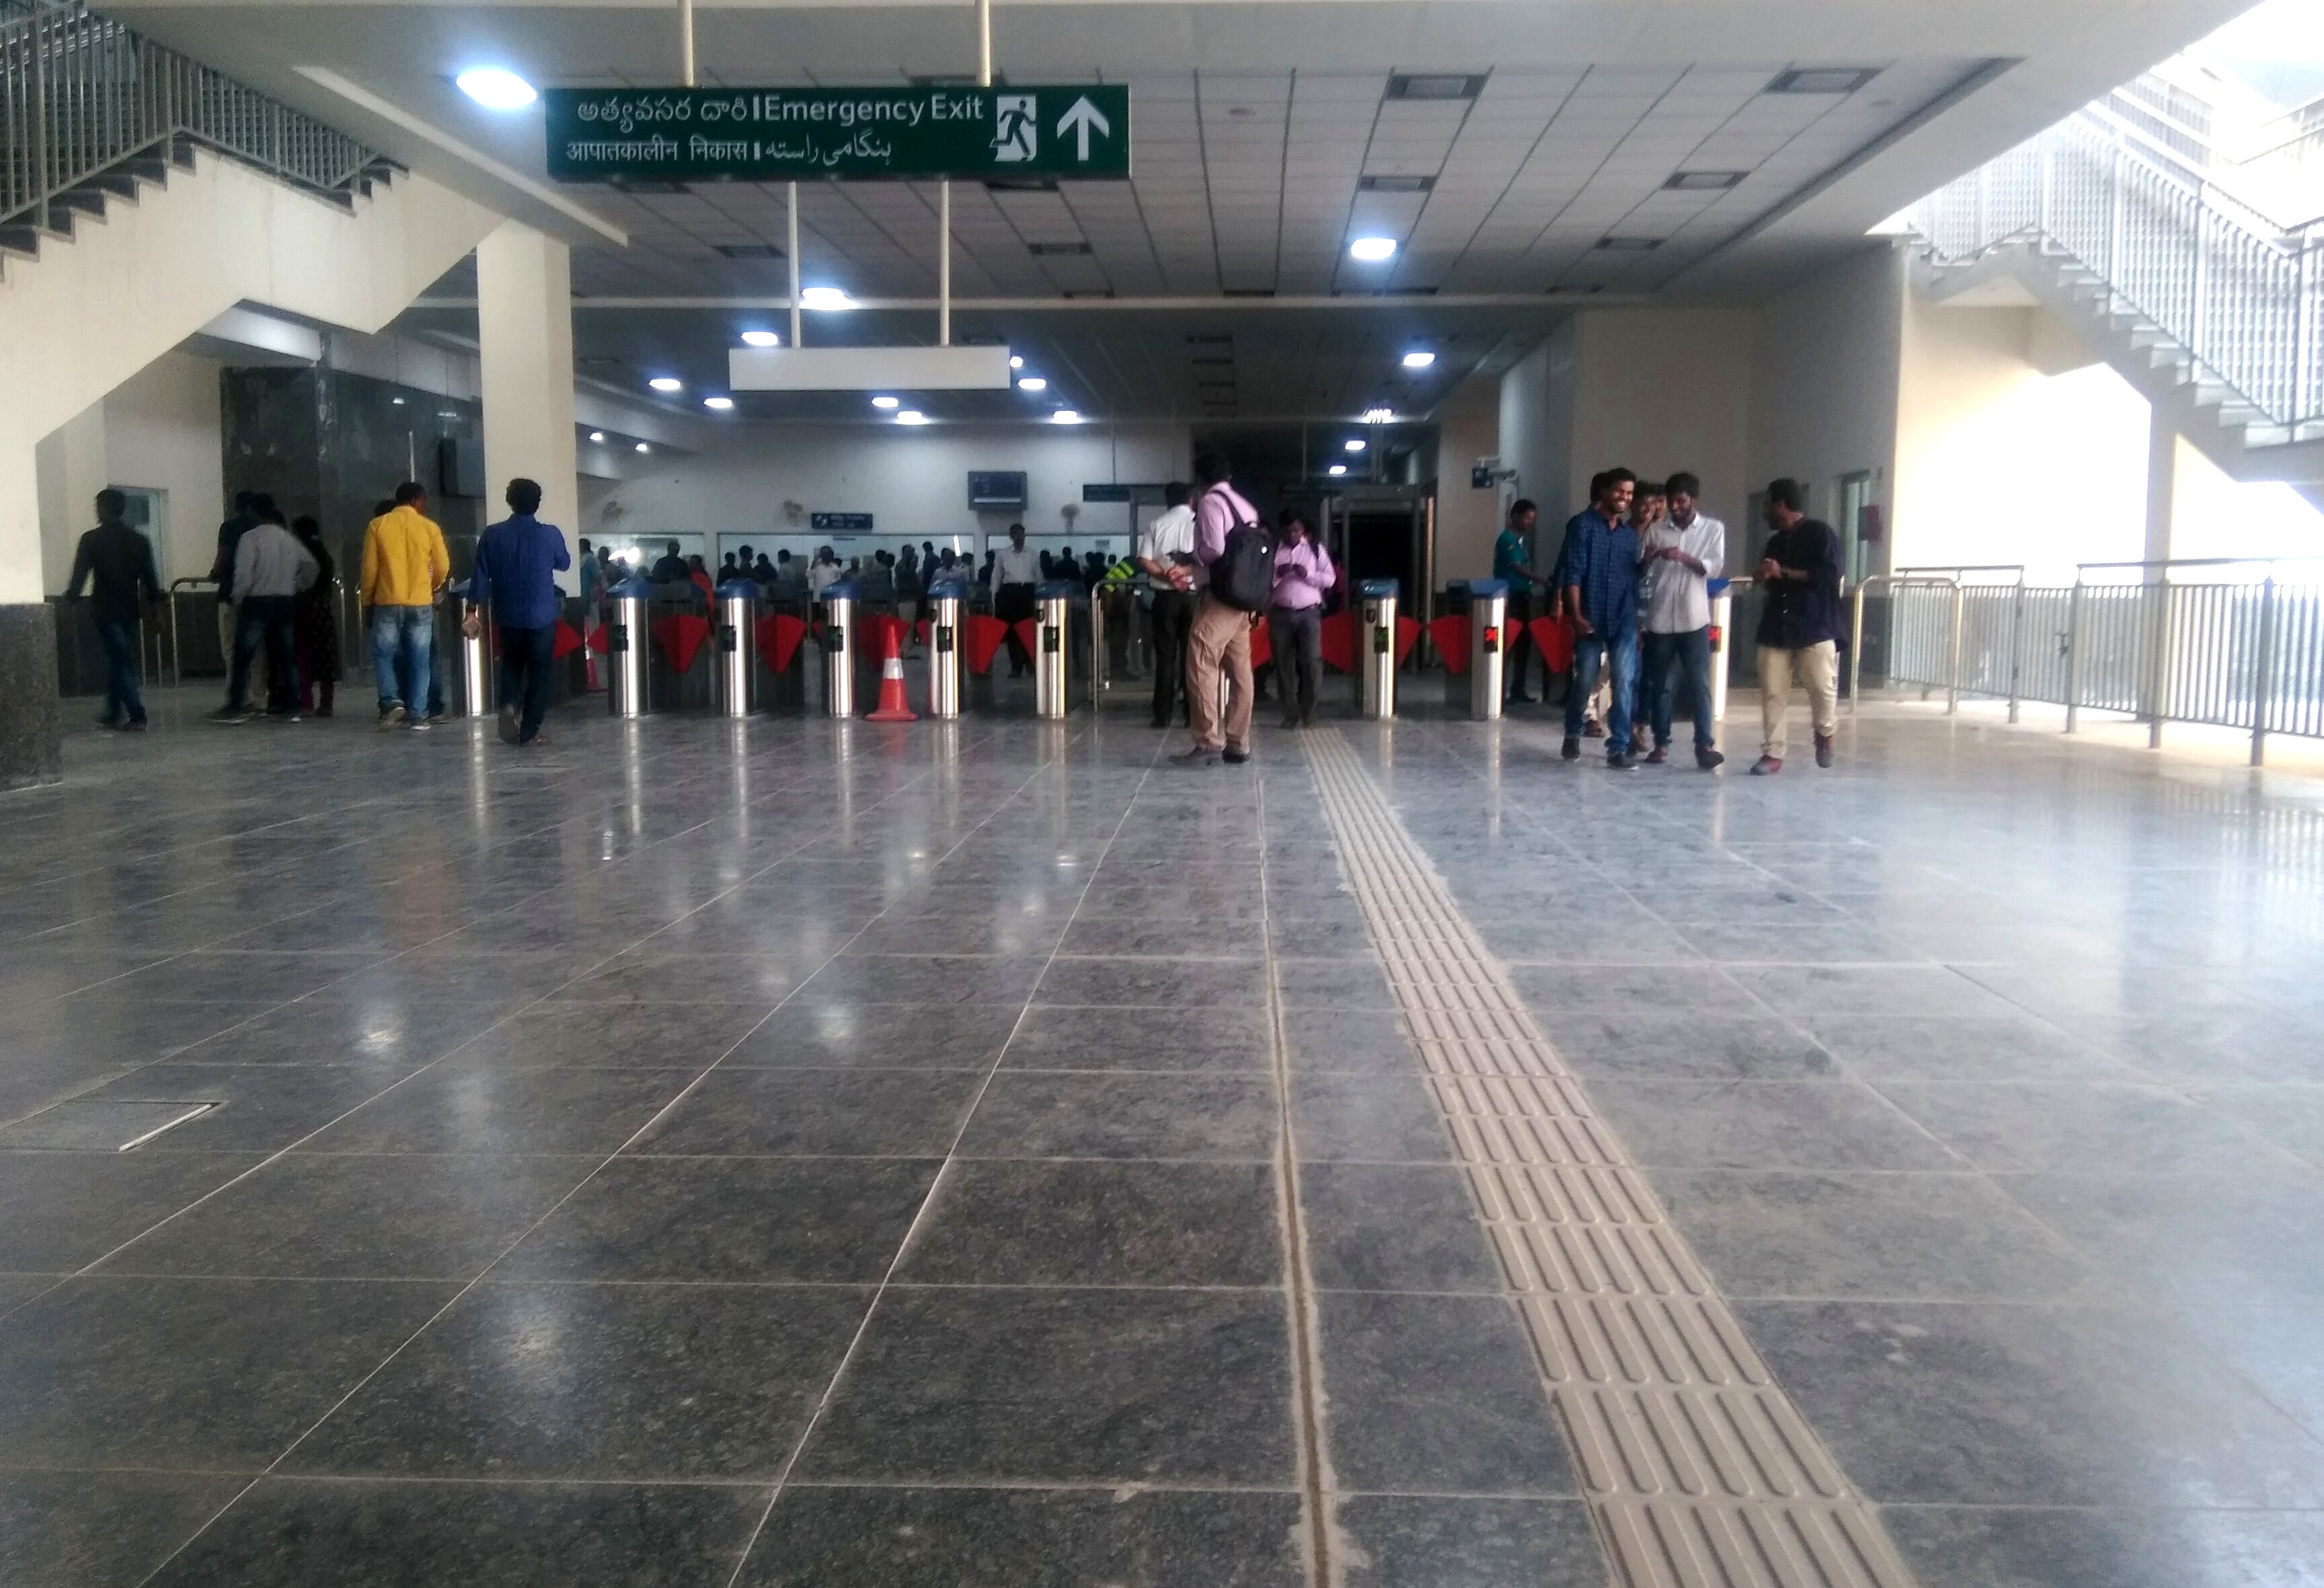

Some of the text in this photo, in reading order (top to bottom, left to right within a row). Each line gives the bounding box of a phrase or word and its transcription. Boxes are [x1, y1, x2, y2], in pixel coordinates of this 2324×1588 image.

[577, 96, 747, 133] అత్యవసర దారి
[765, 93, 983, 127] Emergency Exit
[566, 133, 748, 161] आपातकालीन निकास
